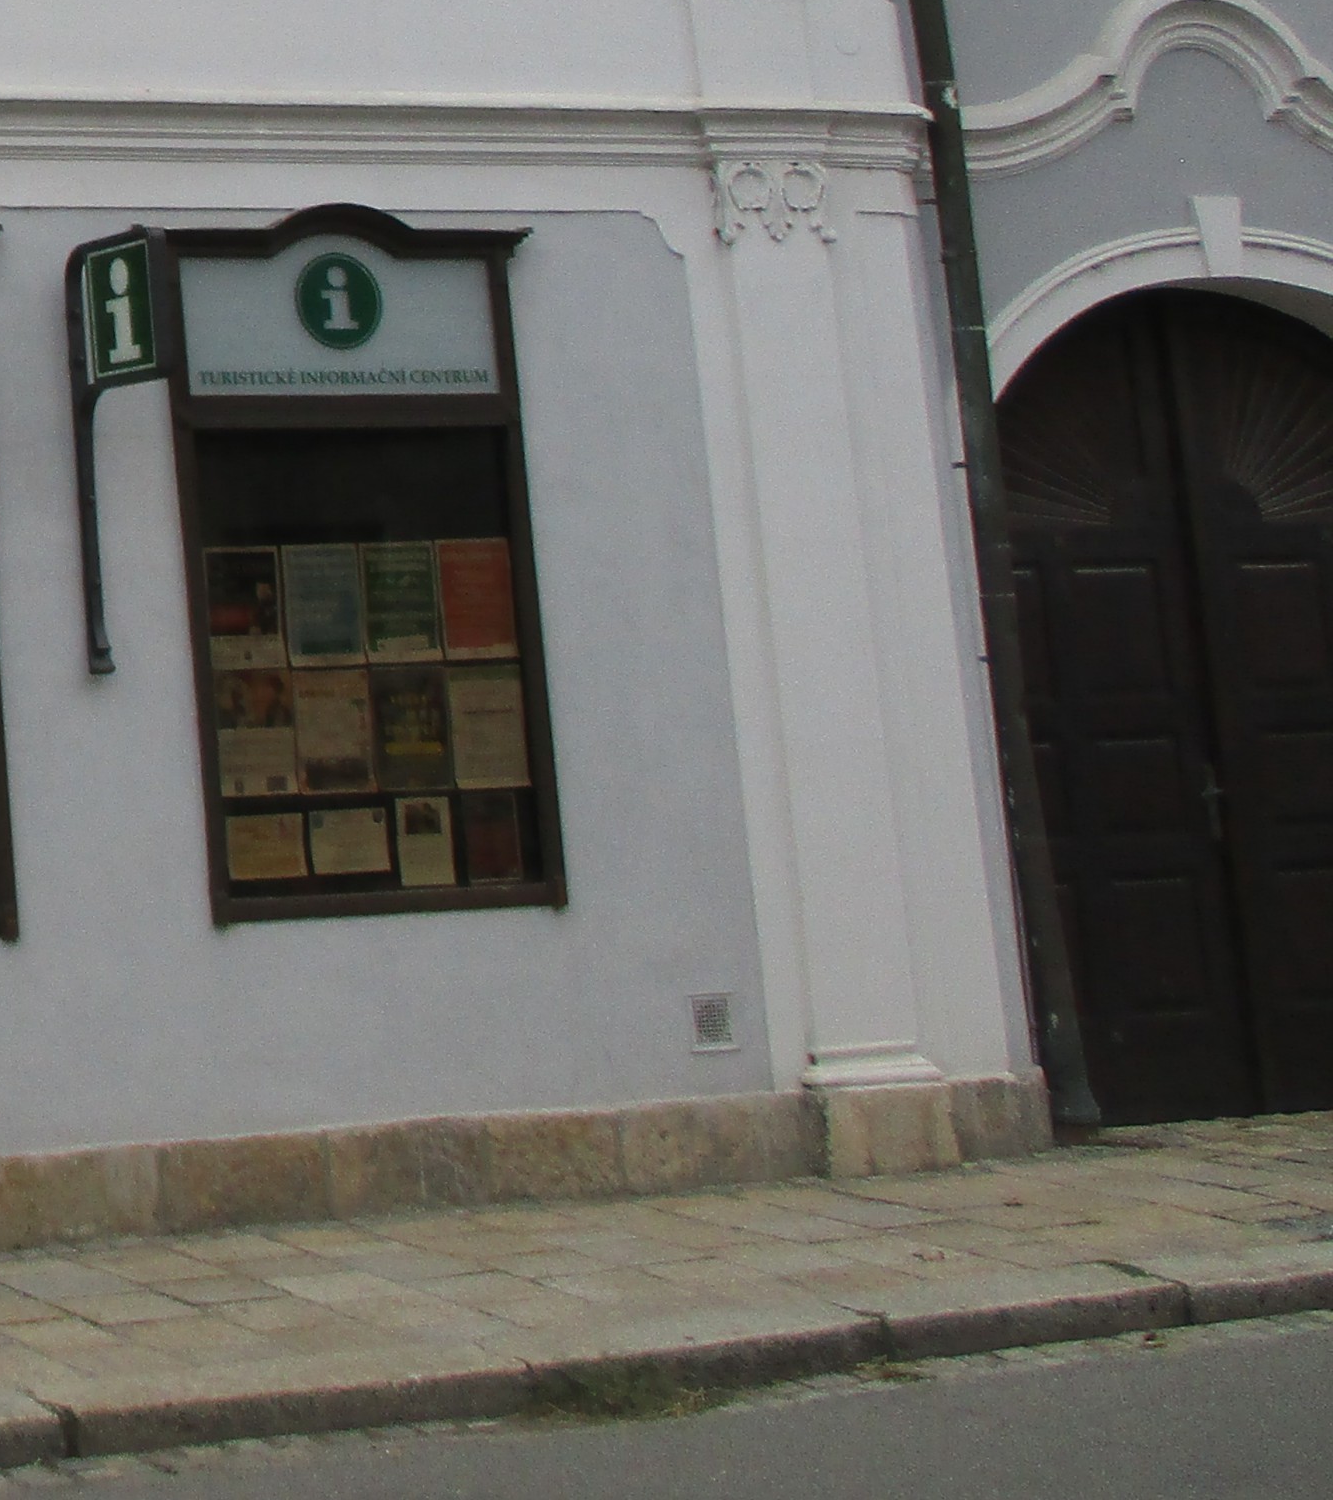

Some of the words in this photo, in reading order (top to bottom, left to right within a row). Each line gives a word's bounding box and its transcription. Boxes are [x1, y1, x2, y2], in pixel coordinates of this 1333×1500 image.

[199, 368, 296, 386] TURISTICKÉ
[300, 368, 406, 385] INFORMAČNÍ
[409, 369, 489, 385] CENTRUM
